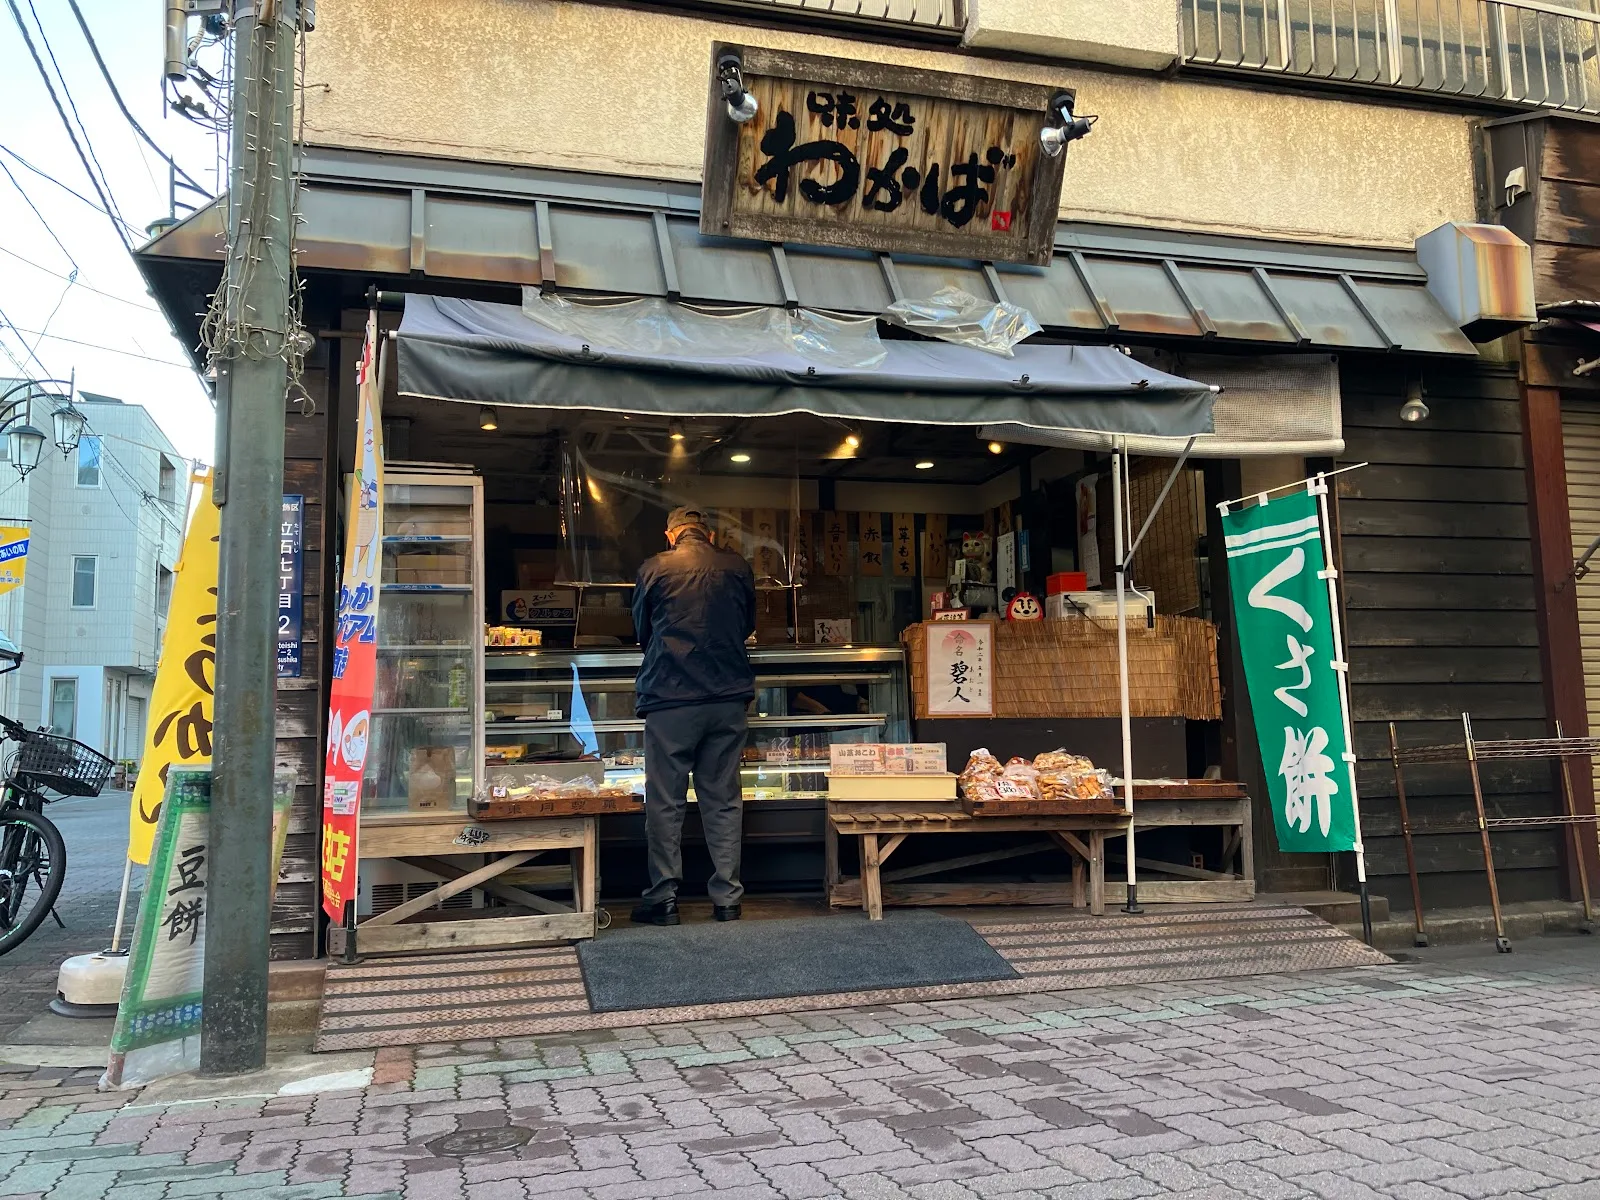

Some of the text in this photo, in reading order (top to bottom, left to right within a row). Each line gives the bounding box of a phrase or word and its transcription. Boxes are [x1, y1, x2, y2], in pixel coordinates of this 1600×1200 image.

[806, 91, 916, 136] 味処
[754, 110, 1017, 229] わかば
[0, 544, 26, 559] あいの町
[954, 633, 965, 657] 命名
[948, 660, 971, 703] 碧人
[1247, 547, 1339, 838] くさ餅
[161, 845, 206, 945] 豆餅
